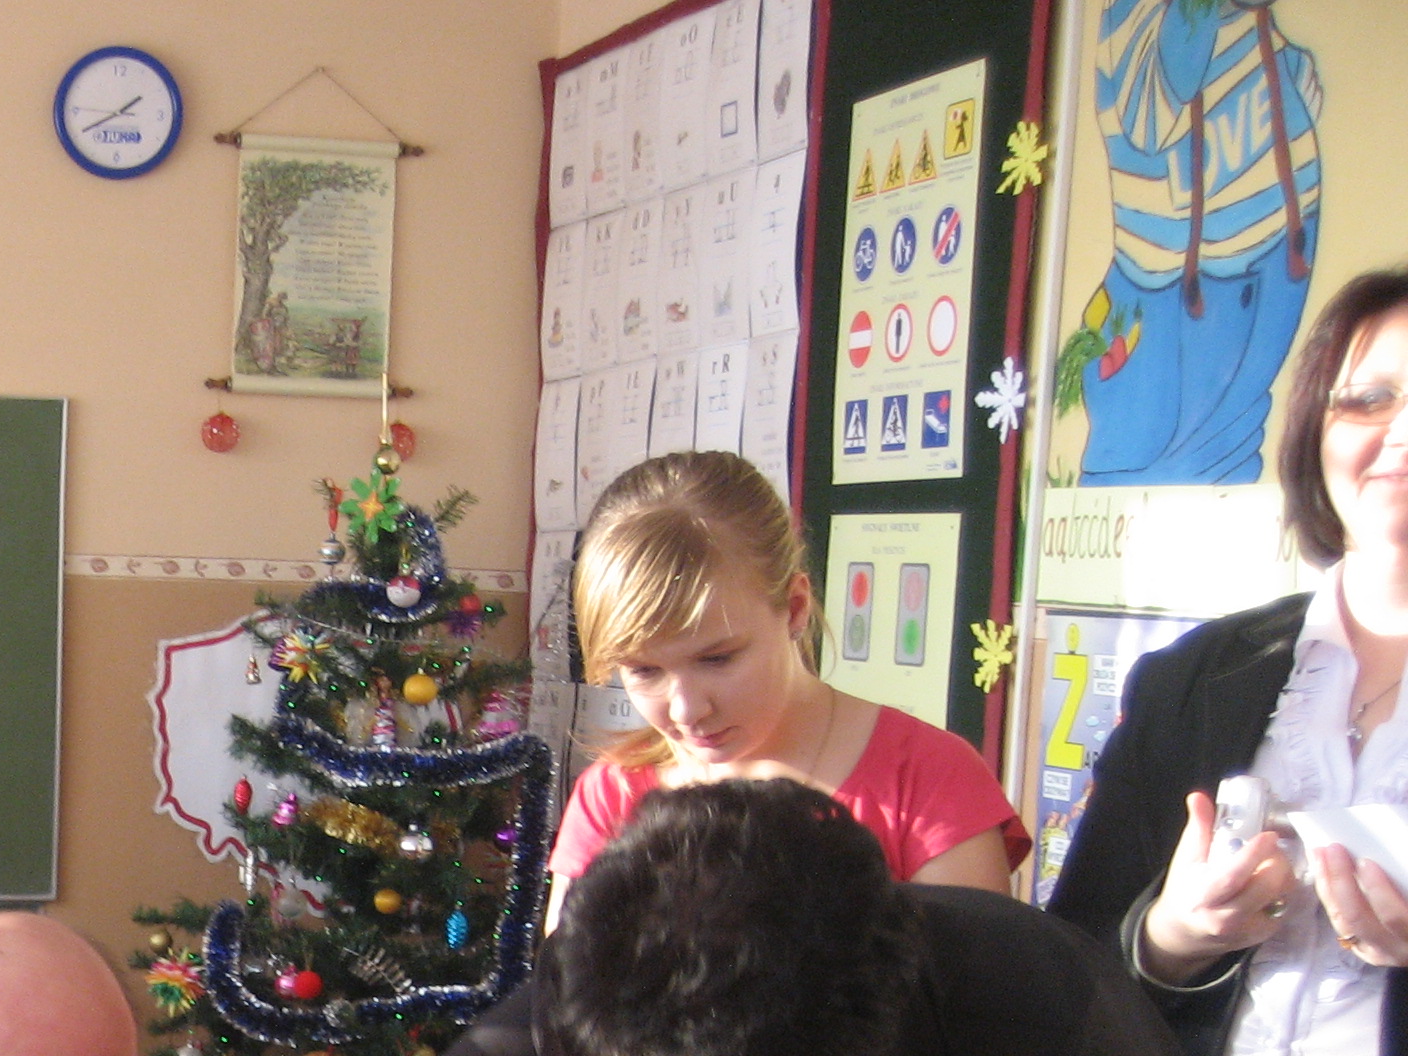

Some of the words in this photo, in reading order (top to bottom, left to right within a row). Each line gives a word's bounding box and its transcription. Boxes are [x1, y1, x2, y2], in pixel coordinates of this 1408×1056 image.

[113, 65, 127, 77] 12
[157, 110, 165, 121] 3
[1167, 84, 1276, 212] LOVE
